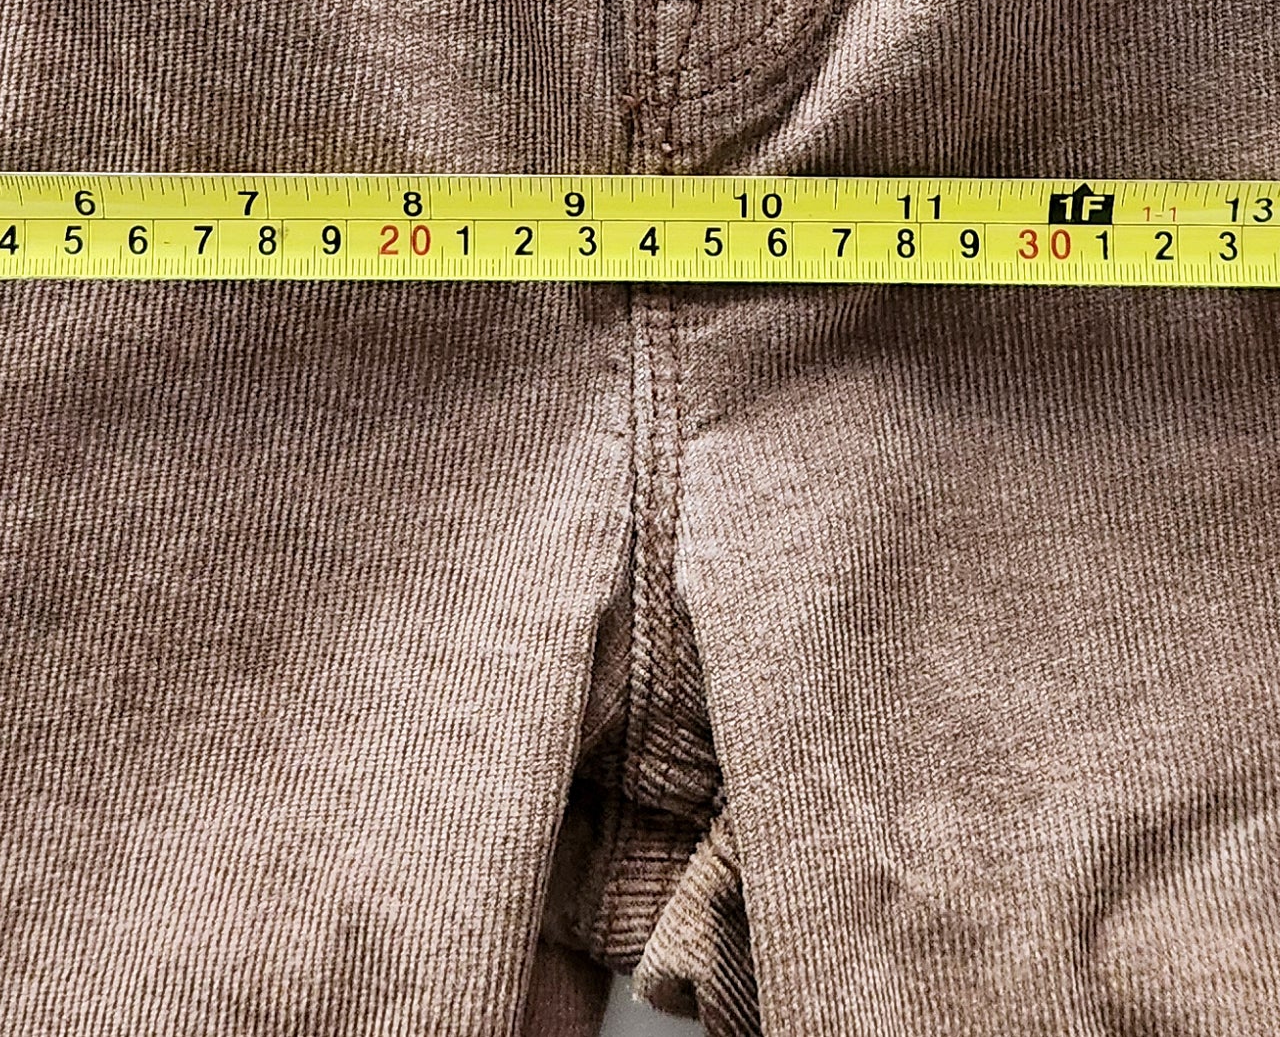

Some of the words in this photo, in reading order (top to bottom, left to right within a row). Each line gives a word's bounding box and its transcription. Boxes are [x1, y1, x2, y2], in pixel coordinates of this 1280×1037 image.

[75, 190, 95, 215] 6
[239, 191, 259, 216] 7
[403, 191, 423, 216] 8
[565, 192, 585, 217] 9
[734, 193, 782, 219] 10
[898, 194, 941, 220] 11
[1059, 195, 1105, 221] 1F
[1143, 206, 1177, 222] 1-1
[1226, 198, 1273, 223] 13
[0, 225, 20, 255] 4
[65, 226, 83, 255] 5
[128, 226, 148, 255] 6
[193, 226, 214, 255] 7
[258, 226, 277, 255] 8
[322, 226, 341, 255] 9
[380, 225, 431, 256] 20
[456, 226, 469, 255] 1
[514, 226, 534, 256] 2
[578, 227, 597, 256] 3
[639, 227, 660, 256] 4
[705, 228, 724, 257] 5
[768, 228, 787, 257] 6
[832, 228, 852, 257] 7
[897, 229, 915, 258] 8
[960, 229, 980, 258] 9
[1019, 229, 1071, 260] 30
[1095, 230, 1108, 260] 1
[1155, 231, 1174, 261] 2
[1219, 231, 1238, 261] 3
